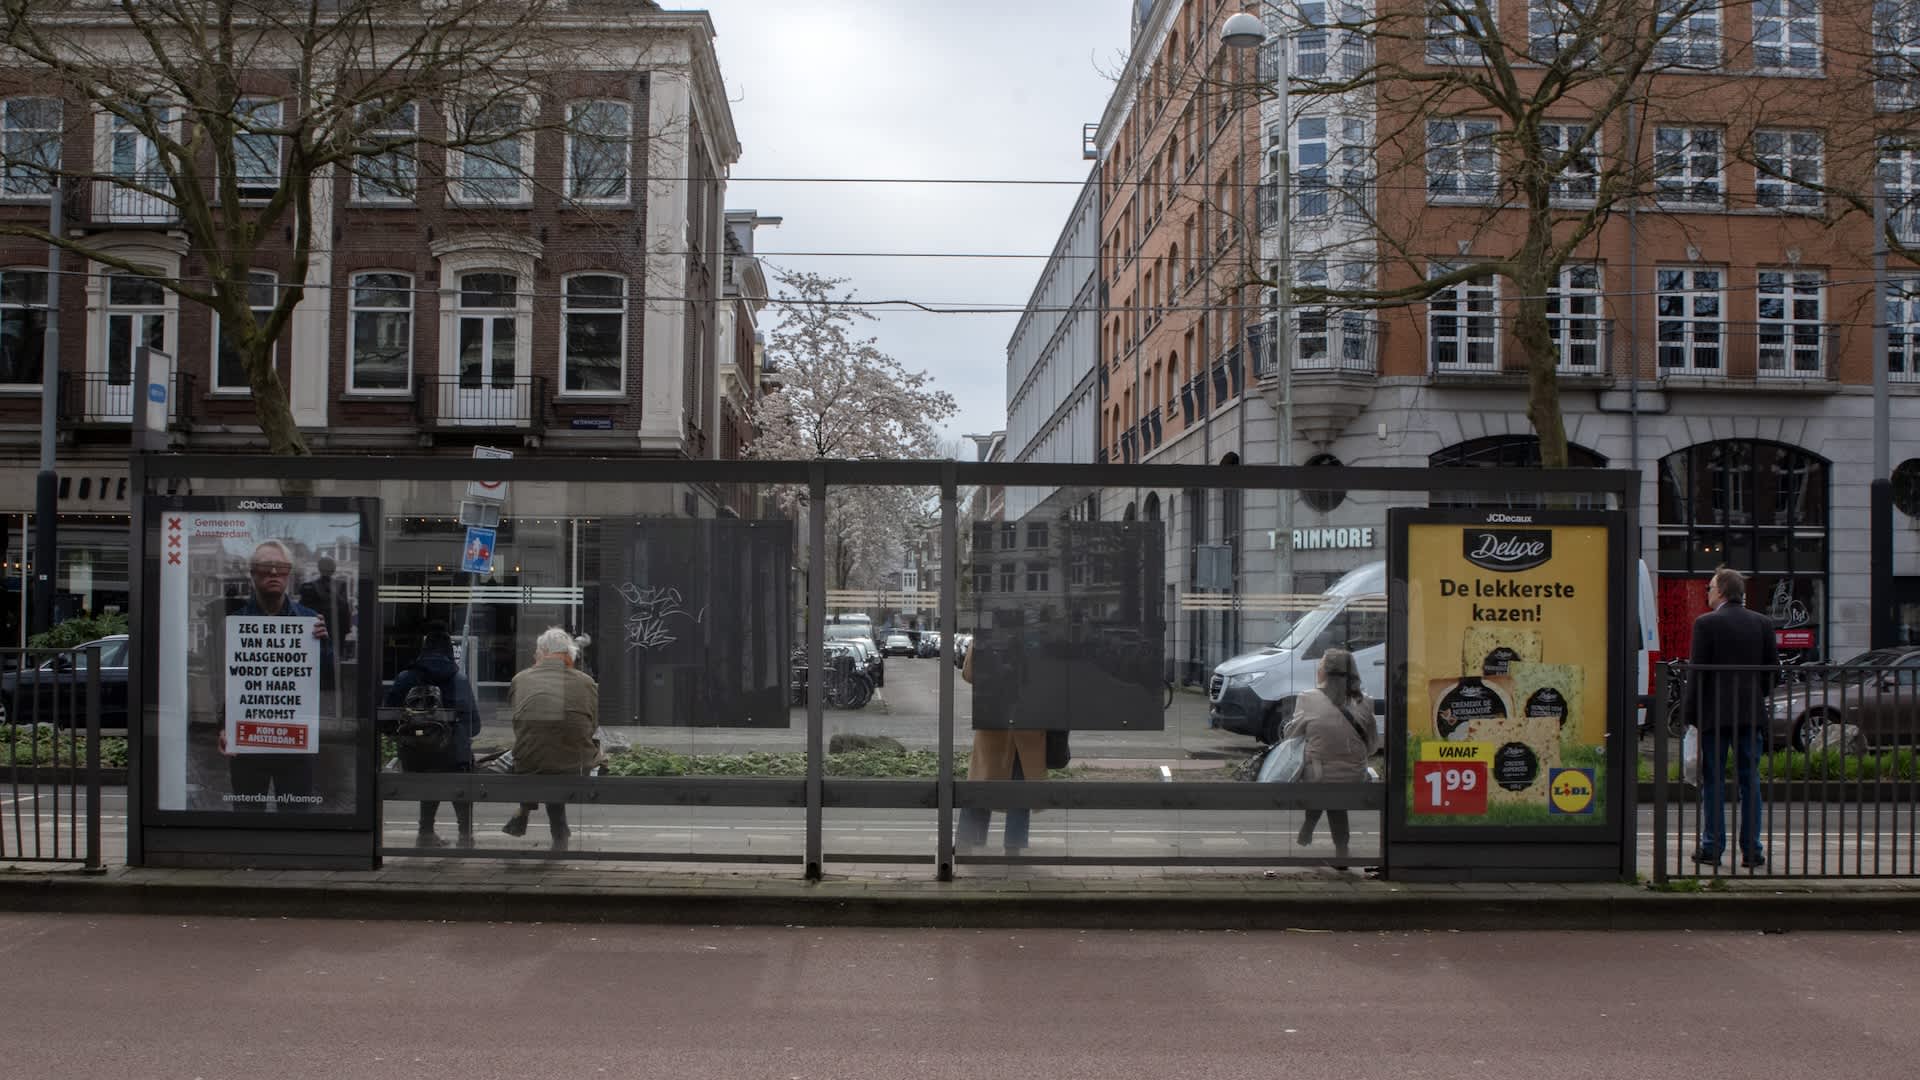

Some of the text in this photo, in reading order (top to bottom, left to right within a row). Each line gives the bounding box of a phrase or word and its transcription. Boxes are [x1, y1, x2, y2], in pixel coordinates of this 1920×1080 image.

[58, 477, 129, 500] HOTE
[237, 501, 283, 510] JCDecaux
[194, 518, 246, 528] Gemeente
[1486, 513, 1533, 523] JCDecaux
[1267, 528, 1373, 550] TAINMORE
[1470, 533, 1545, 562] Deluxe
[1440, 578, 1575, 598] De lekkerste
[1472, 603, 1542, 622] kazen!
[238, 623, 304, 634] ZEG ER IETS
[240, 637, 301, 649] VAN ALS JE
[234, 651, 308, 663] KLASGENOOT
[229, 665, 313, 678] WORDT GEPEST
[244, 680, 296, 692] OM HAAR
[239, 694, 302, 706] AZIATISCHE
[245, 708, 296, 720] AFKOMST
[256, 726, 289, 736] KOM OP
[247, 734, 296, 745] AMSTERDAM
[1438, 746, 1479, 759] VANAF
[1424, 768, 1478, 807] 1.99
[222, 793, 324, 805] amsterdam.nl/komop
